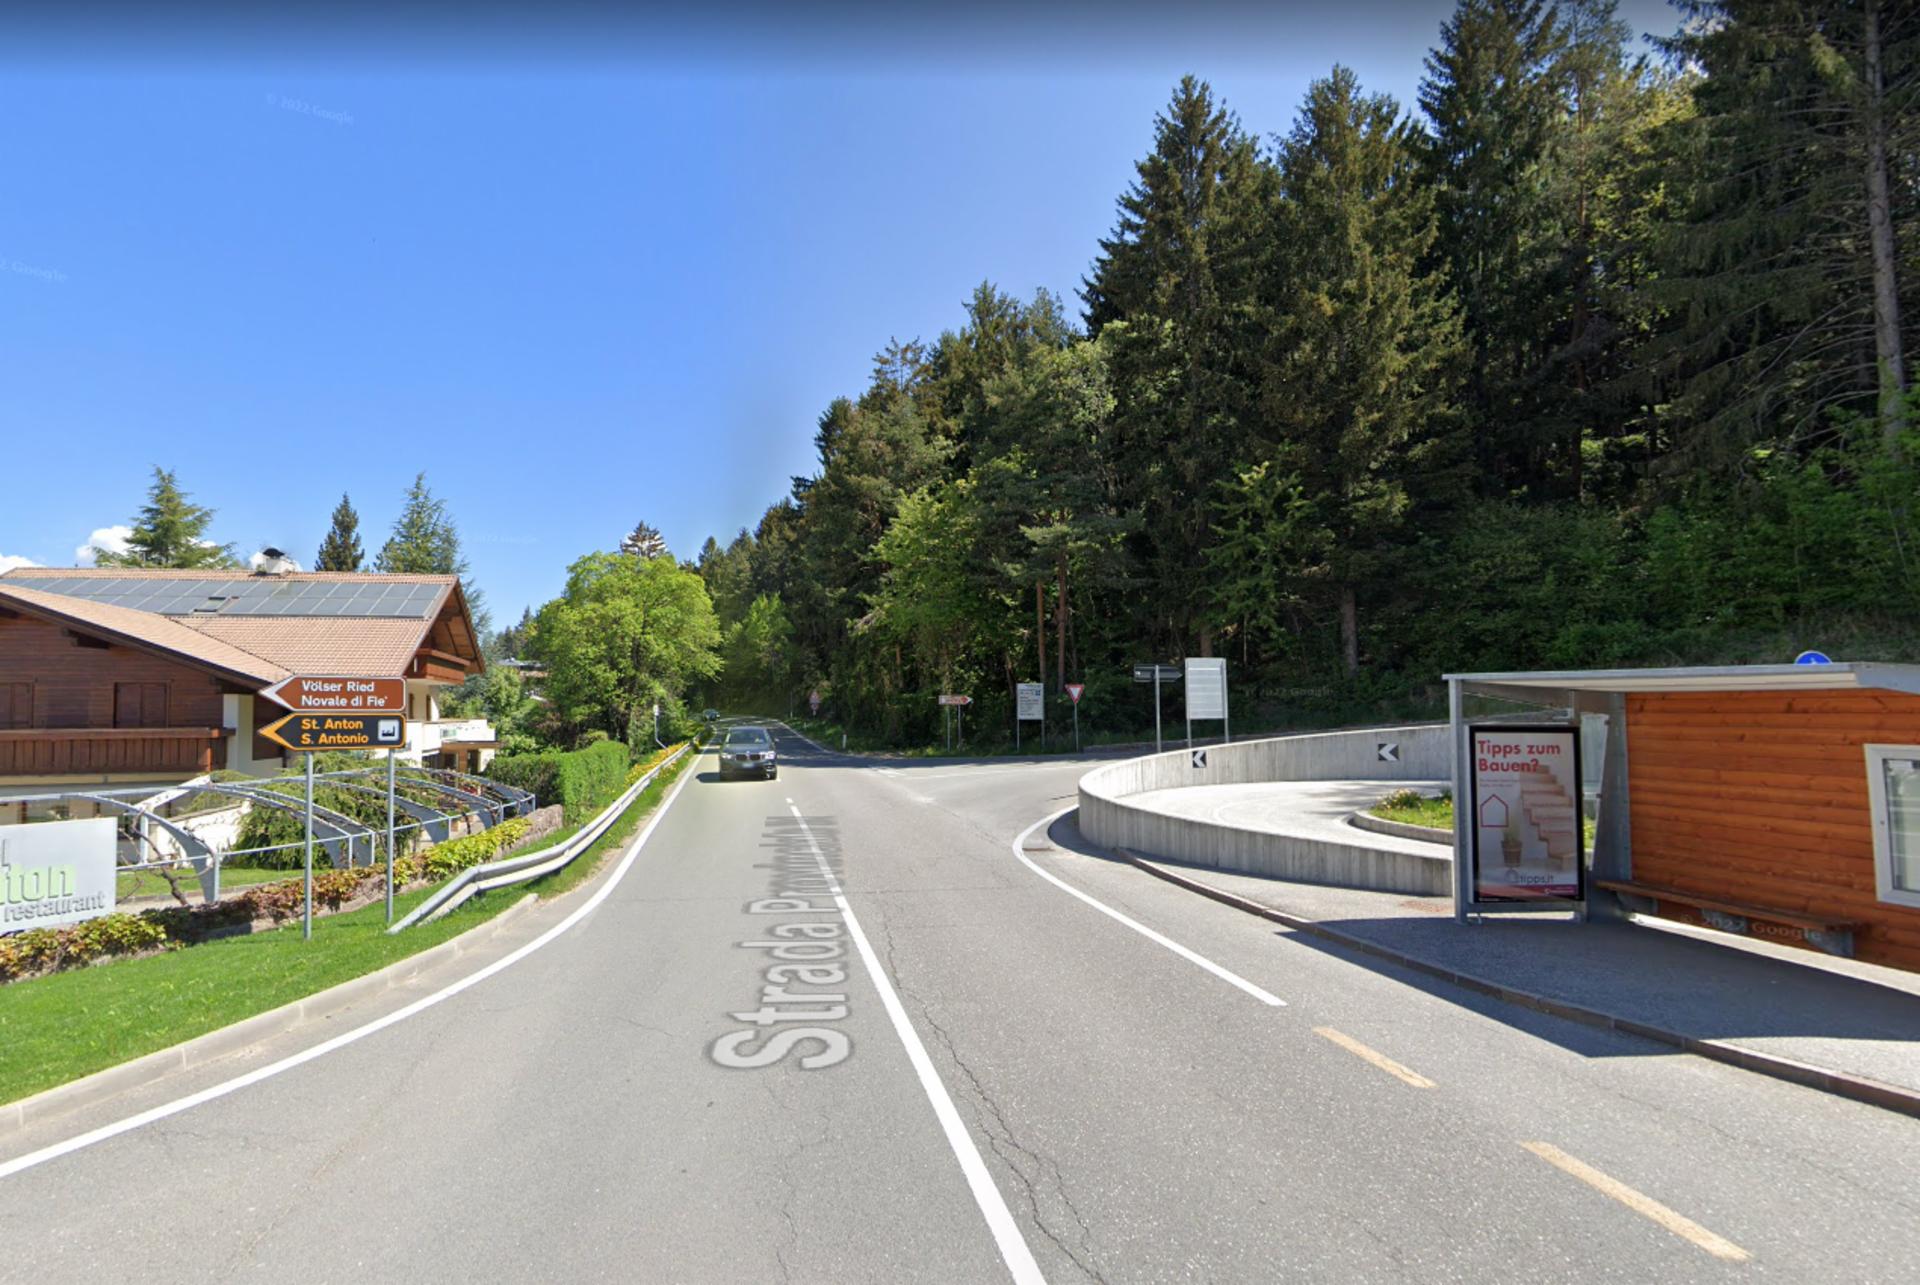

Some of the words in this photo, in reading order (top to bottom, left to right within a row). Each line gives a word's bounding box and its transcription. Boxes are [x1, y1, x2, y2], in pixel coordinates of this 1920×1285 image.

[302, 680, 342, 692] Völser
[347, 681, 375, 692] Ried
[301, 695, 347, 706] Novale
[351, 696, 363, 706] di
[301, 719, 320, 730] St.
[324, 719, 363, 730] Anton
[301, 733, 314, 744] S.
[319, 733, 369, 744] Antonio
[1478, 740, 1521, 758] Tipps
[1527, 744, 1561, 755] zum
[1478, 758, 1540, 773] Bauen?
[0, 864, 75, 905] ton
[4, 890, 106, 922] restaurant
